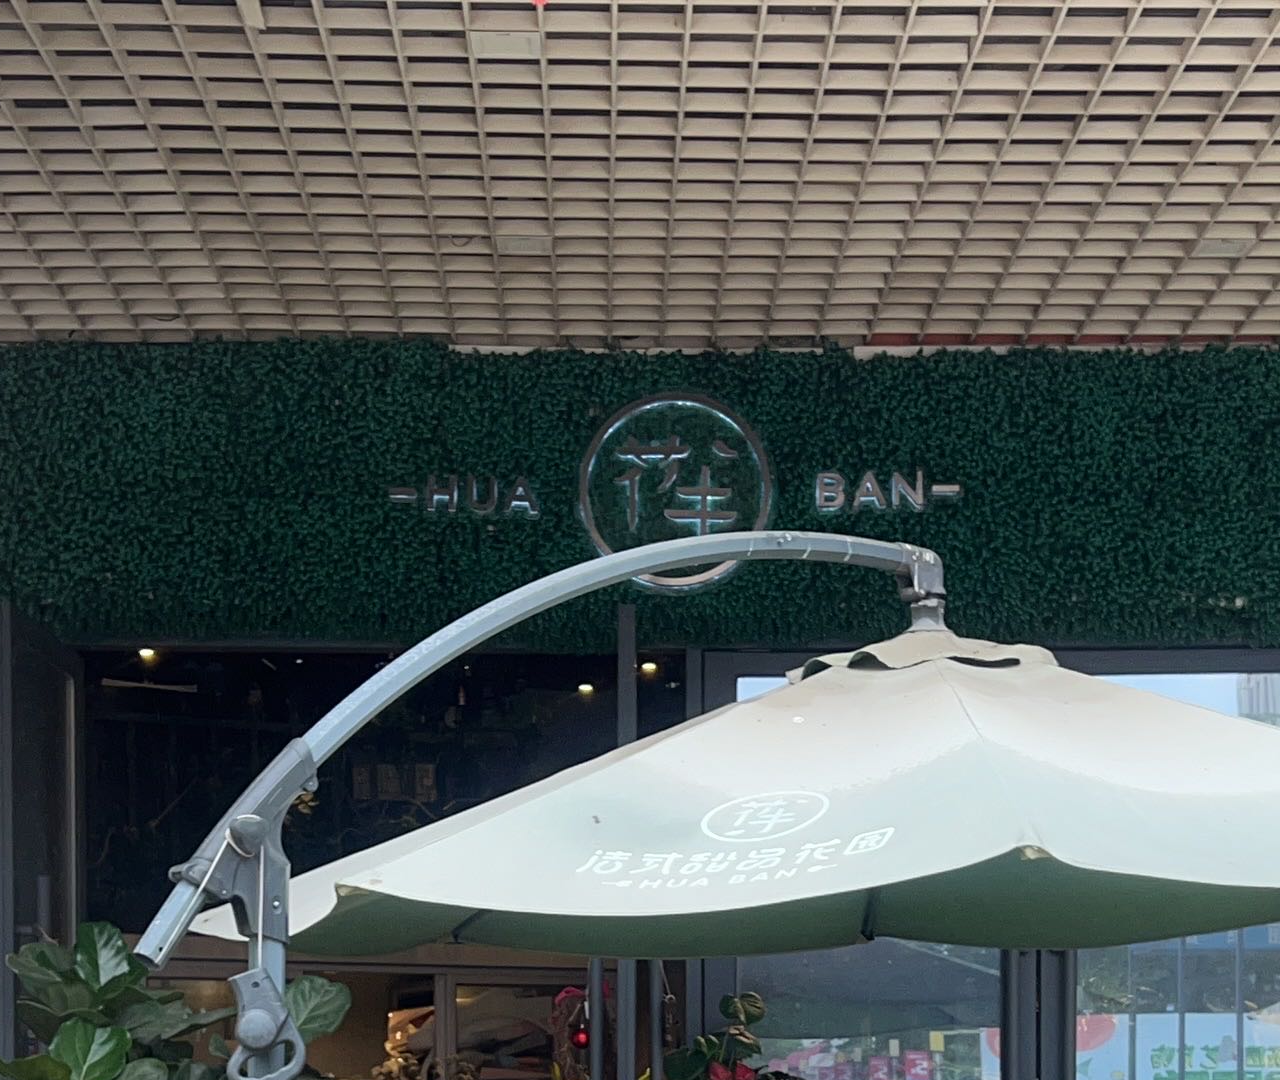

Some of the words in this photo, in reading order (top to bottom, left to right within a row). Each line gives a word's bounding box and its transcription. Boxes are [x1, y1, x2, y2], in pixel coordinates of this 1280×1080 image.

[426, 474, 540, 517] HUA
[815, 469, 925, 513] BAN
[638, 877, 710, 889] HUA
[728, 868, 799, 885] BAN
